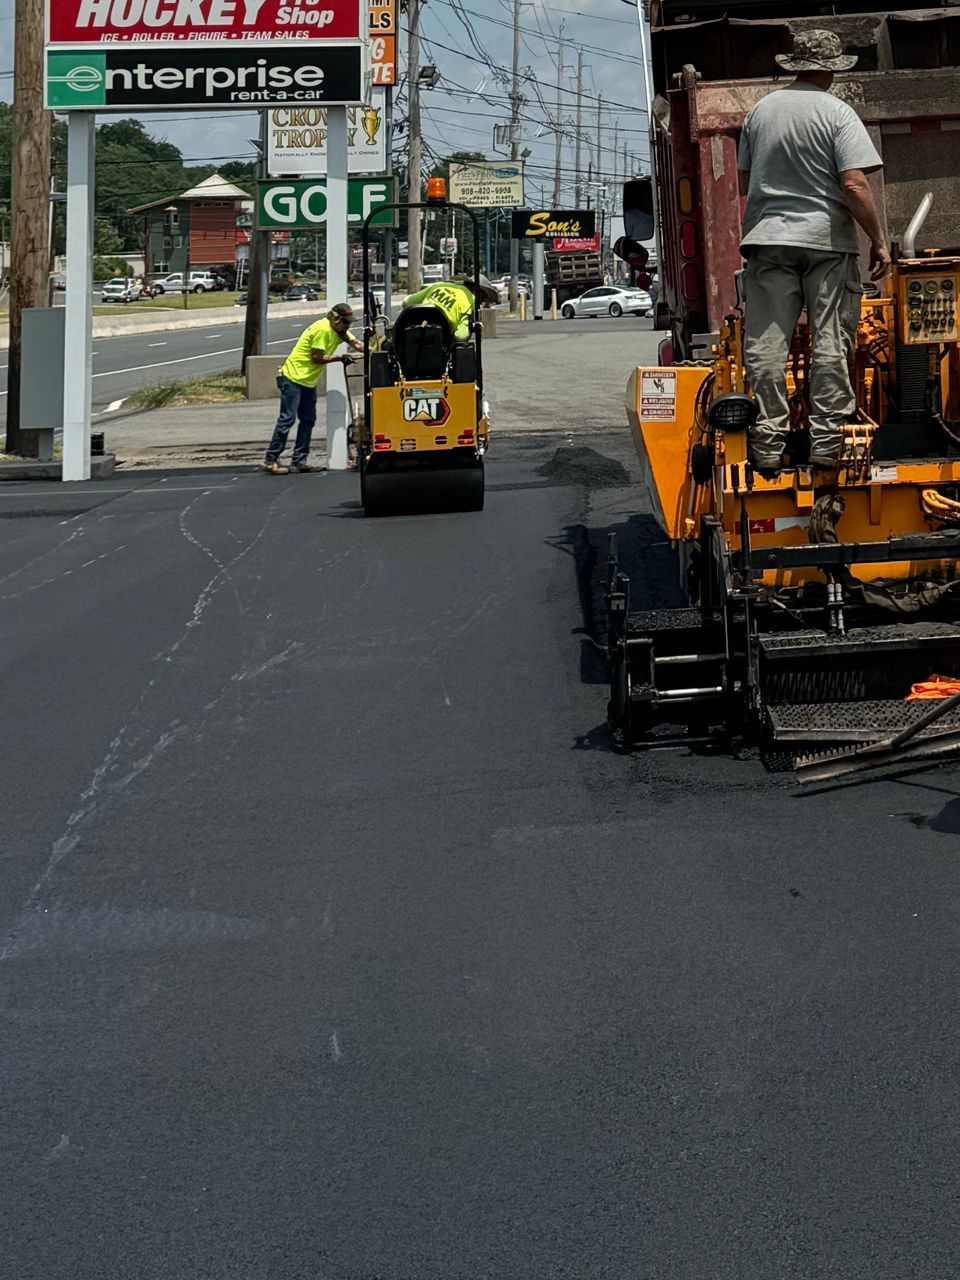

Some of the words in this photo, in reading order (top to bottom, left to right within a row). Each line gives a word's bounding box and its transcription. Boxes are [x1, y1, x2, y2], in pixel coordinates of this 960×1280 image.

[275, 7, 334, 28] Shop
[100, 33, 119, 42] ICE
[131, 32, 175, 42] ROLLER
[187, 31, 228, 41] FIGURE
[241, 31, 272, 40] TEAM
[273, 30, 310, 40] SALES
[66, 58, 325, 97] enterprise
[230, 88, 325, 101] rent-a-car
[273, 128, 358, 149] TROPY
[525, 212, 582, 236] Son's
[403, 399, 440, 421] CAT
